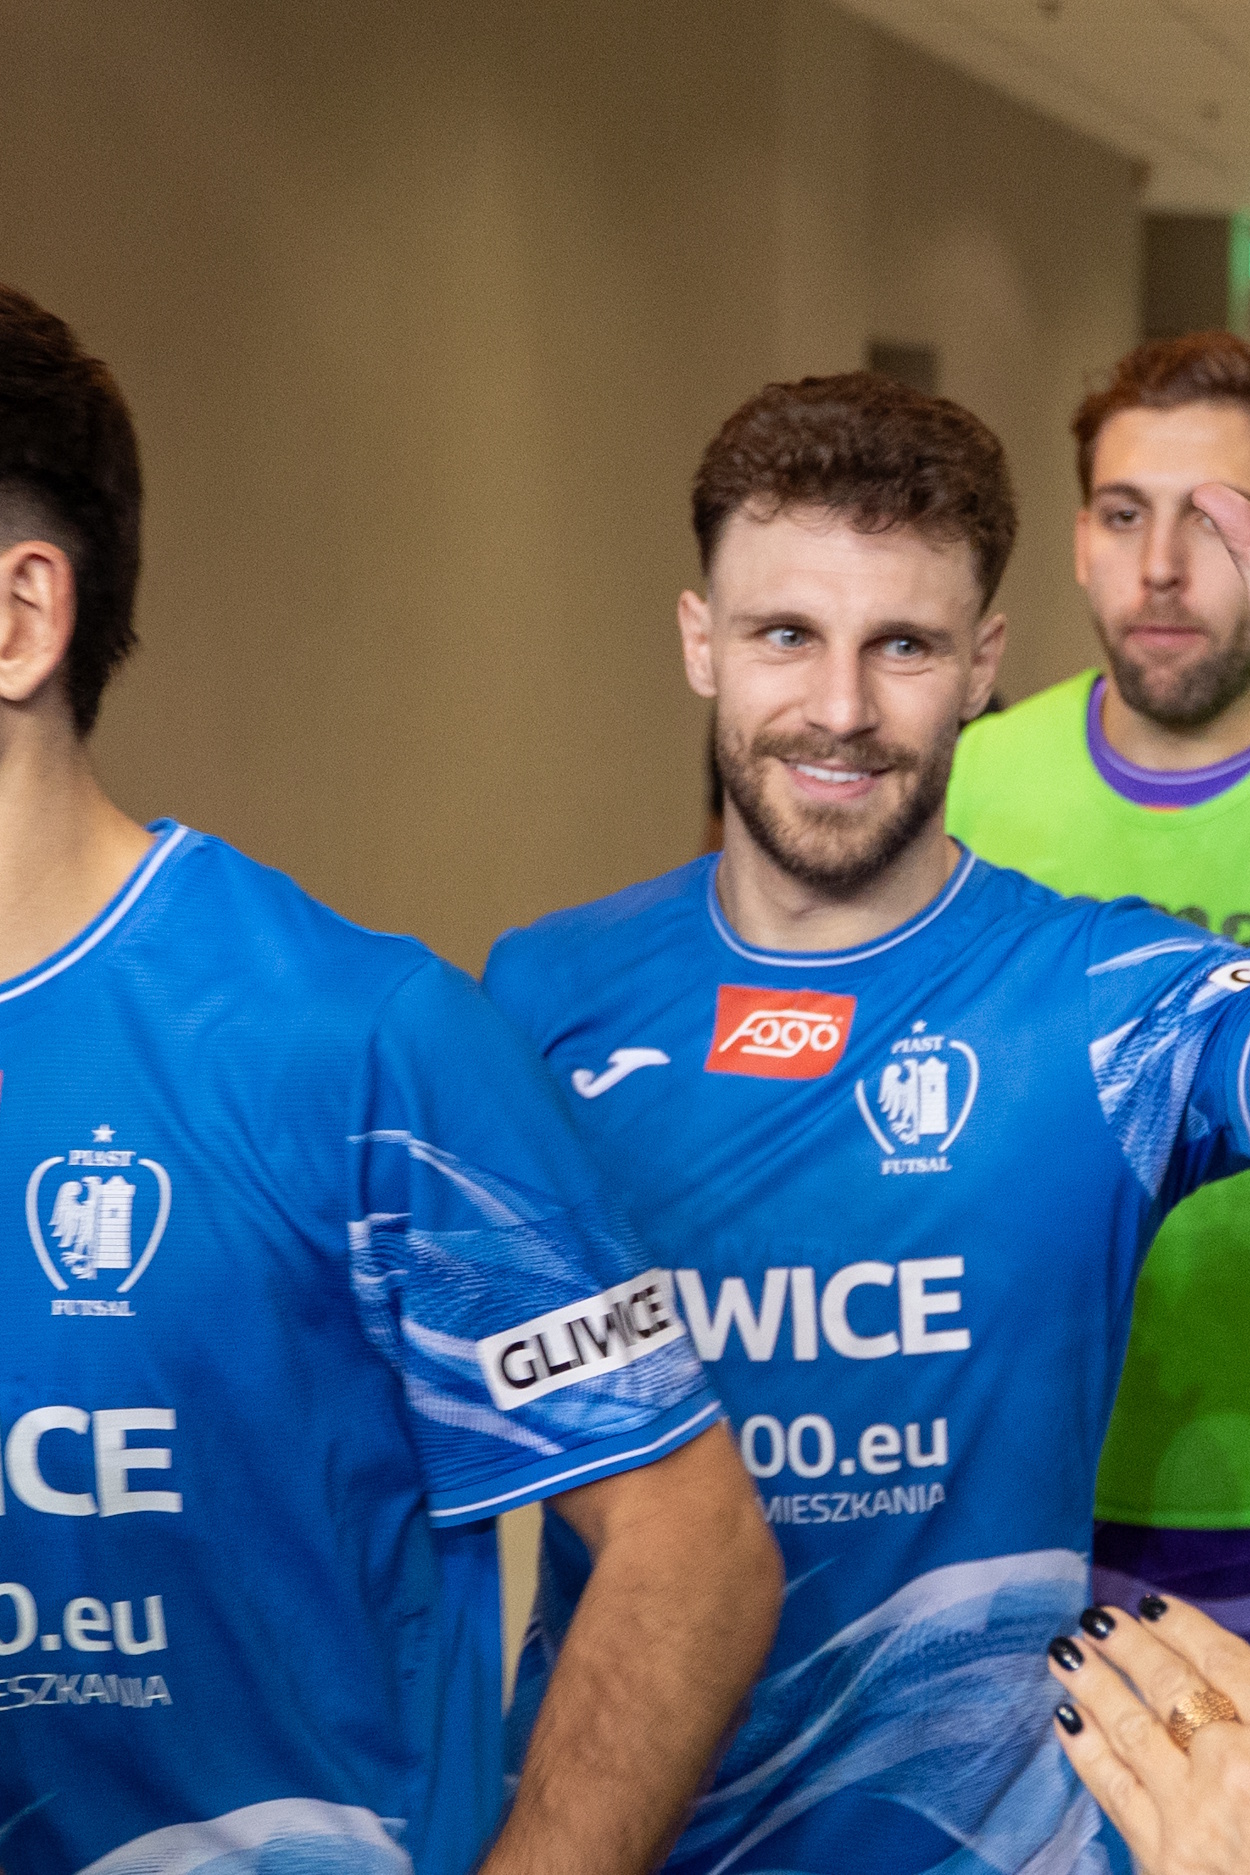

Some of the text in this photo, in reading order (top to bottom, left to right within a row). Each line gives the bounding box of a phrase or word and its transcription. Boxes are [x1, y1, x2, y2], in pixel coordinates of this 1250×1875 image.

[880, 1157, 953, 1175] FUTSAL
[501, 1284, 672, 1389] GLIWICE
[657, 1255, 971, 1362] WICE
[0, 1404, 183, 1518] CE
[740, 1413, 948, 1479] 00.eu
